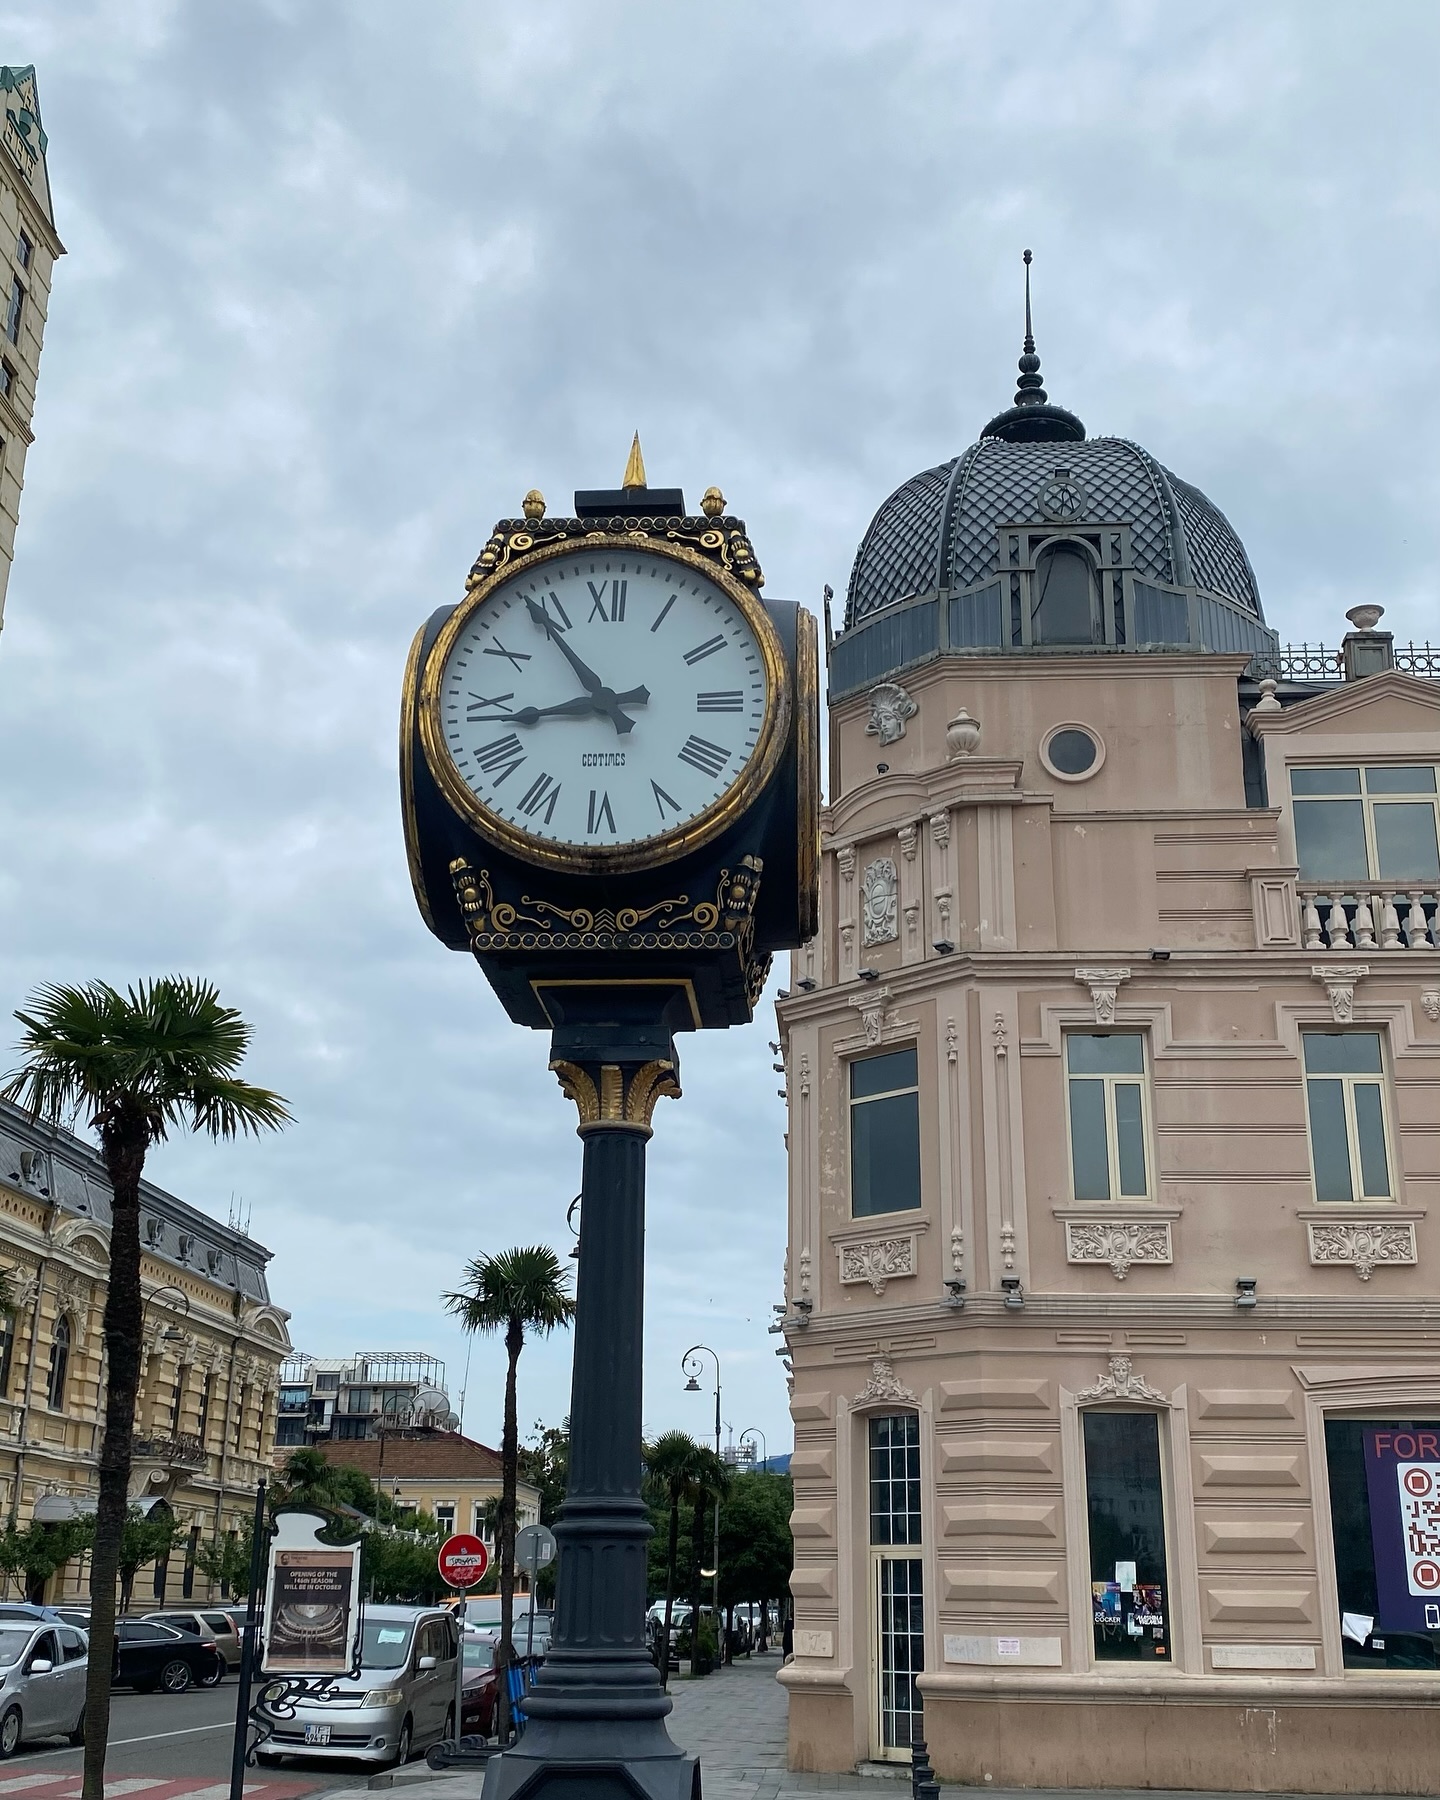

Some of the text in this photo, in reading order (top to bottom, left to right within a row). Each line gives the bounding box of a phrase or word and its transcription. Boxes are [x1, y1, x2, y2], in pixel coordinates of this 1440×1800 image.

[587, 580, 627, 622] XII
[650, 594, 677, 632] I
[483, 636, 532, 673] X
[683, 634, 728, 666] II
[697, 690, 744, 713] III
[473, 733, 528, 788] VIII
[516, 772, 563, 825] VII
[587, 790, 617, 834] VI
[650, 778, 682, 820] V
